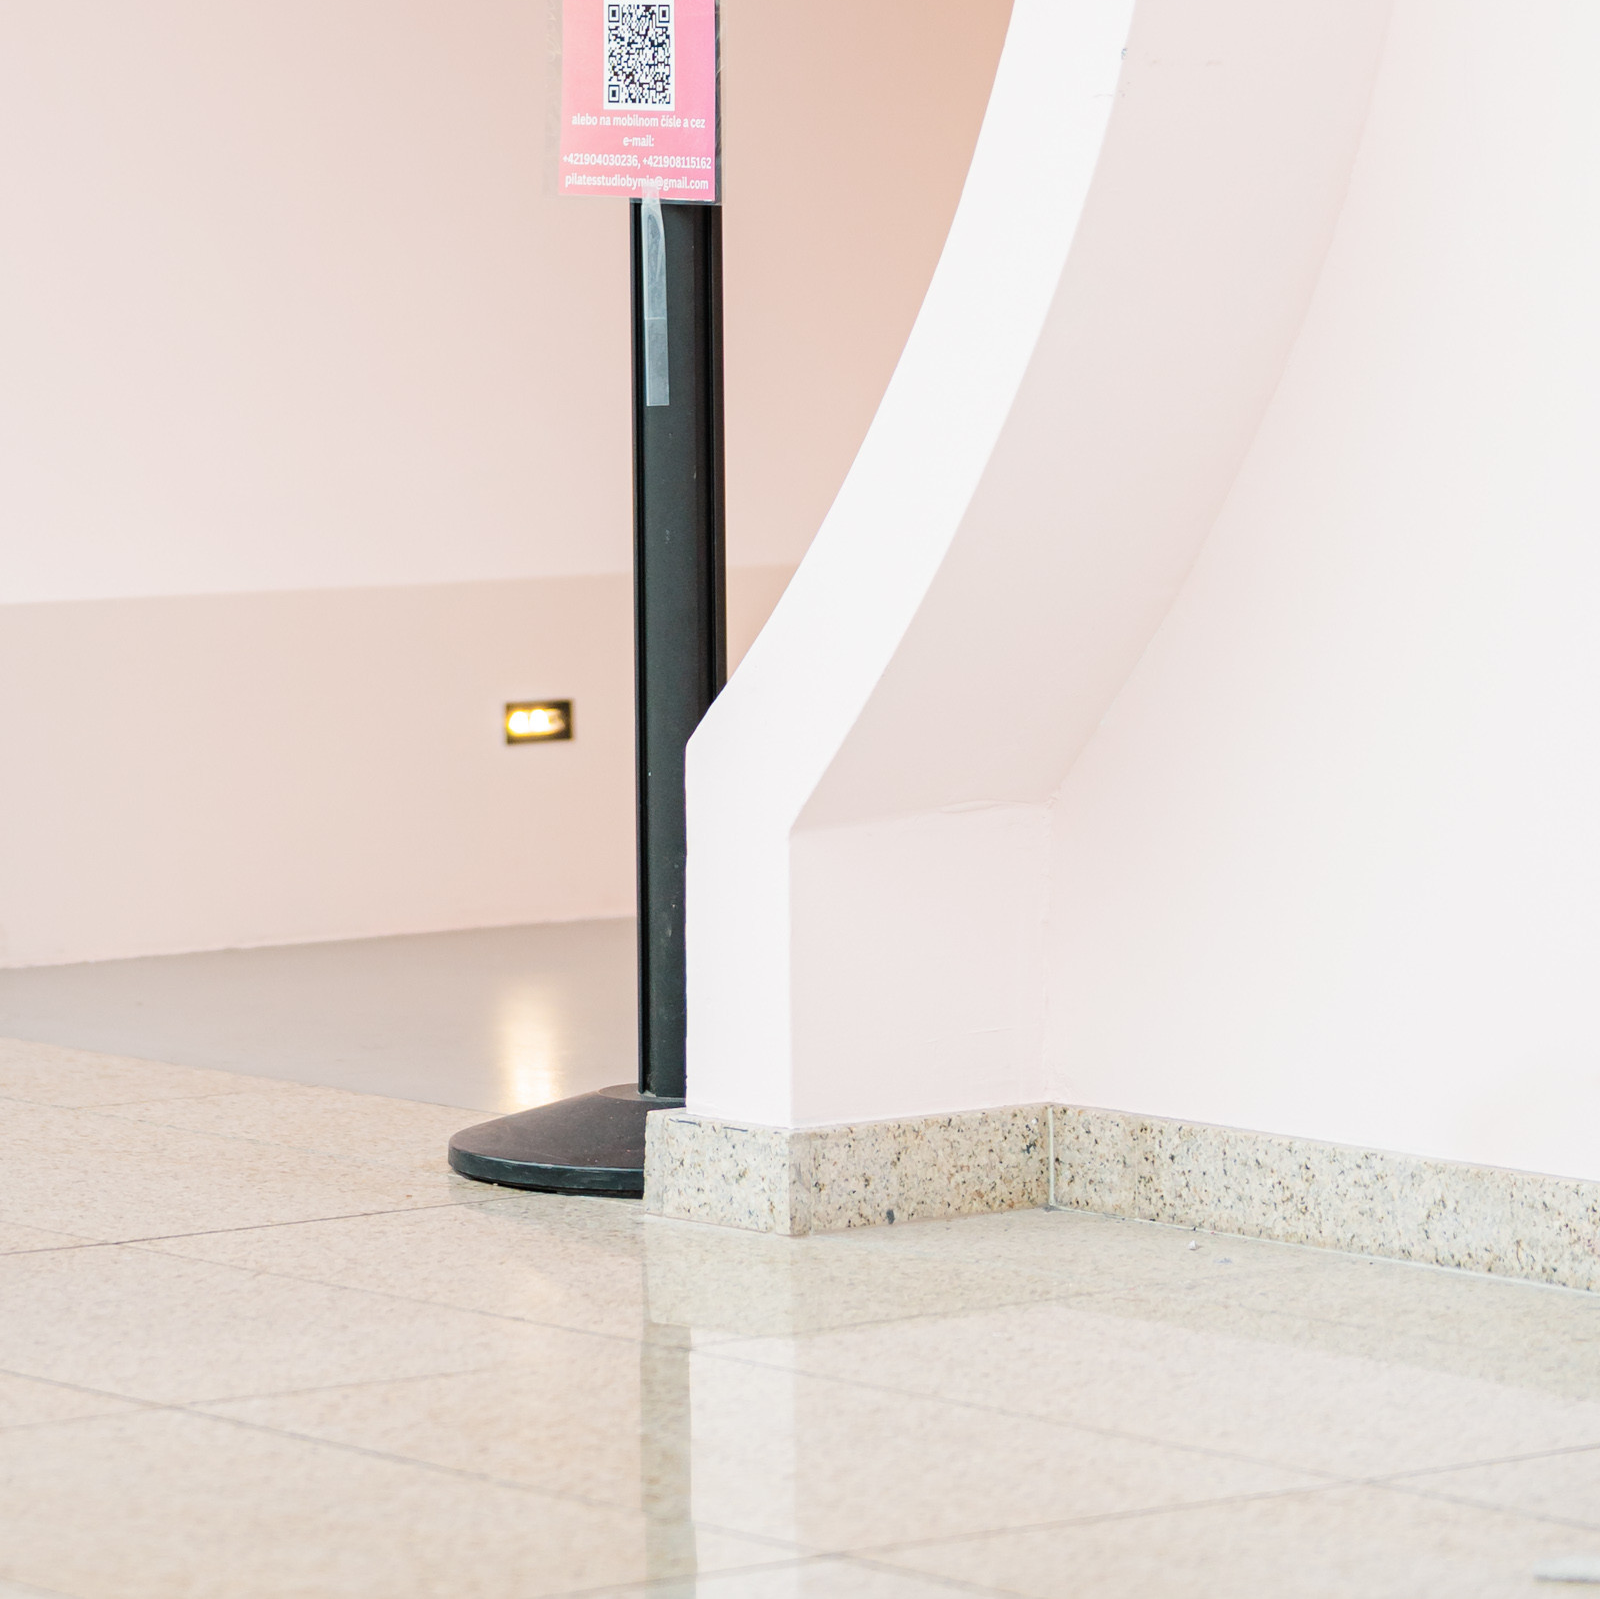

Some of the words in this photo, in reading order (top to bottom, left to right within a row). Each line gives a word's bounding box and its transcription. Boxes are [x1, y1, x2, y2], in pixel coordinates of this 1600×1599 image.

[571, 113, 598, 126] alebo
[600, 116, 611, 125] na
[612, 114, 659, 128] mobilnom
[660, 114, 682, 128] čísle
[682, 119, 689, 128] a
[690, 119, 706, 129] cez
[622, 134, 655, 147] e-mail:
